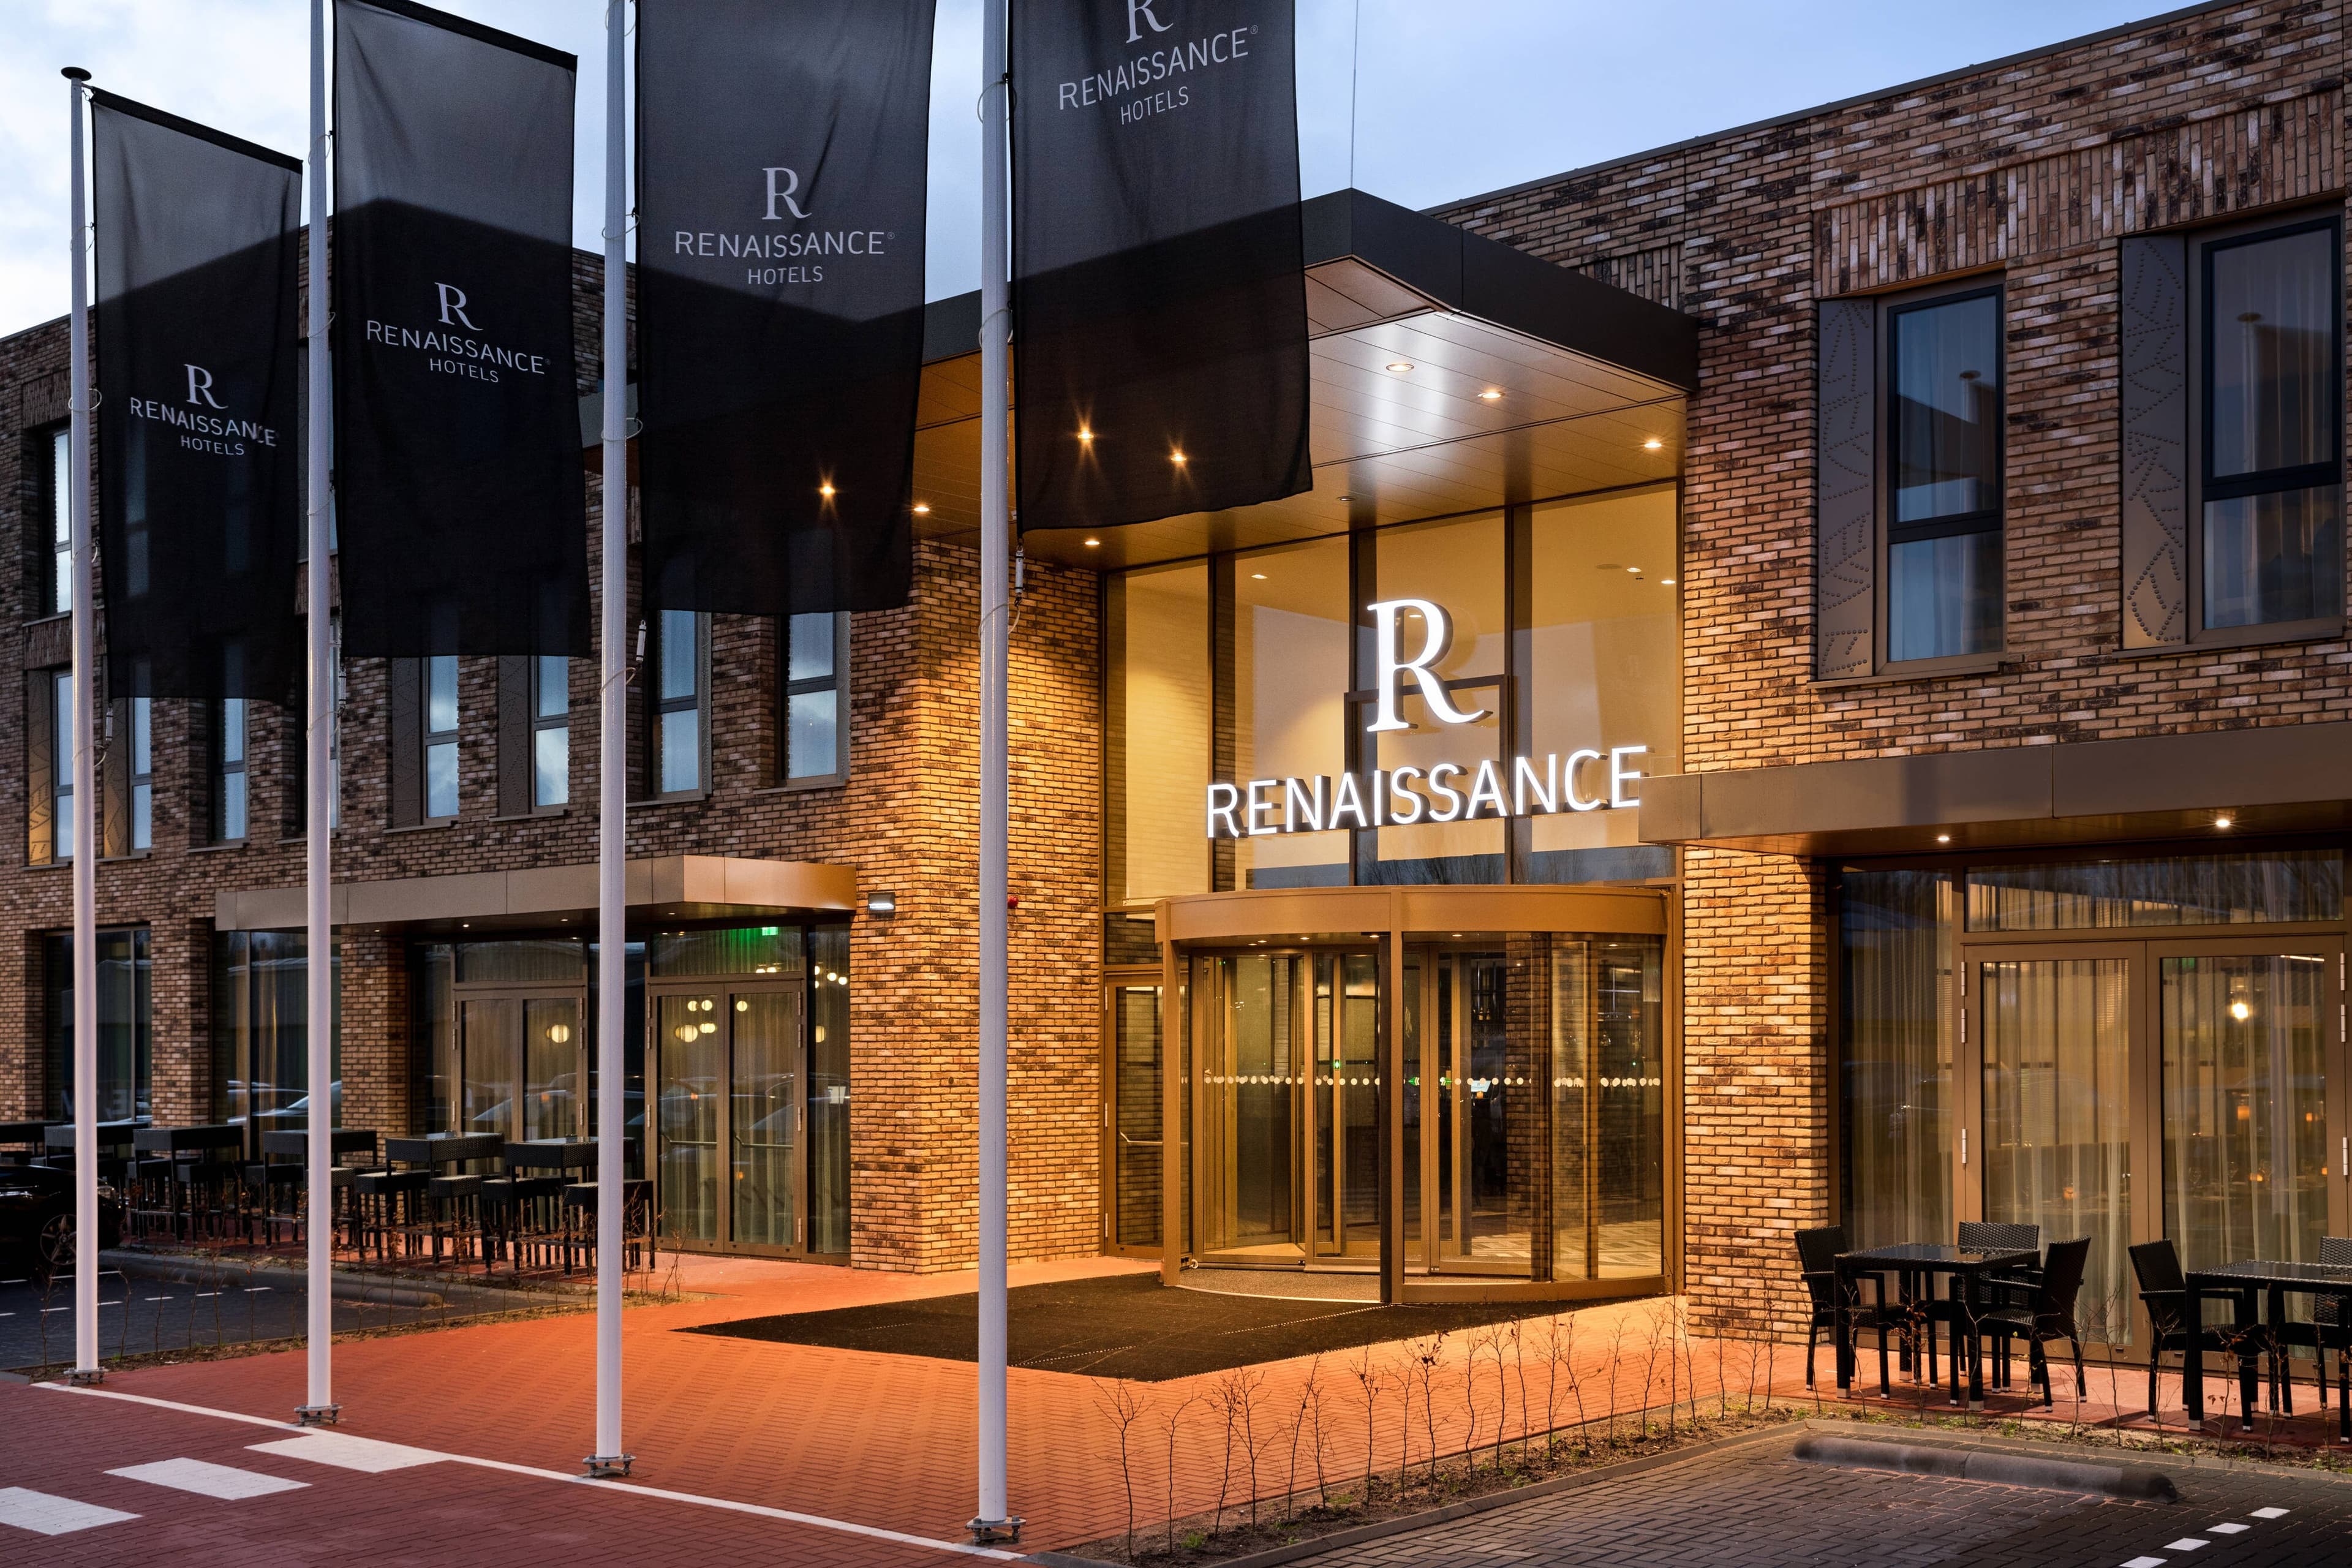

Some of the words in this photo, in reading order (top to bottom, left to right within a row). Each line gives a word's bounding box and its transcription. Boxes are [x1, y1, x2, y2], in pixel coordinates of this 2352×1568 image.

[1125, 0, 1174, 44] R
[1120, 86, 1189, 126] HOTELS
[761, 167, 812, 220] R
[748, 265, 823, 285] HOTELS
[434, 282, 484, 331] R
[183, 363, 229, 410] R
[429, 358, 499, 383] HOTELS
[180, 435, 245, 456] HOTELS
[1366, 598, 1486, 733] R
[1207, 745, 1648, 839] RENAISSANCE
